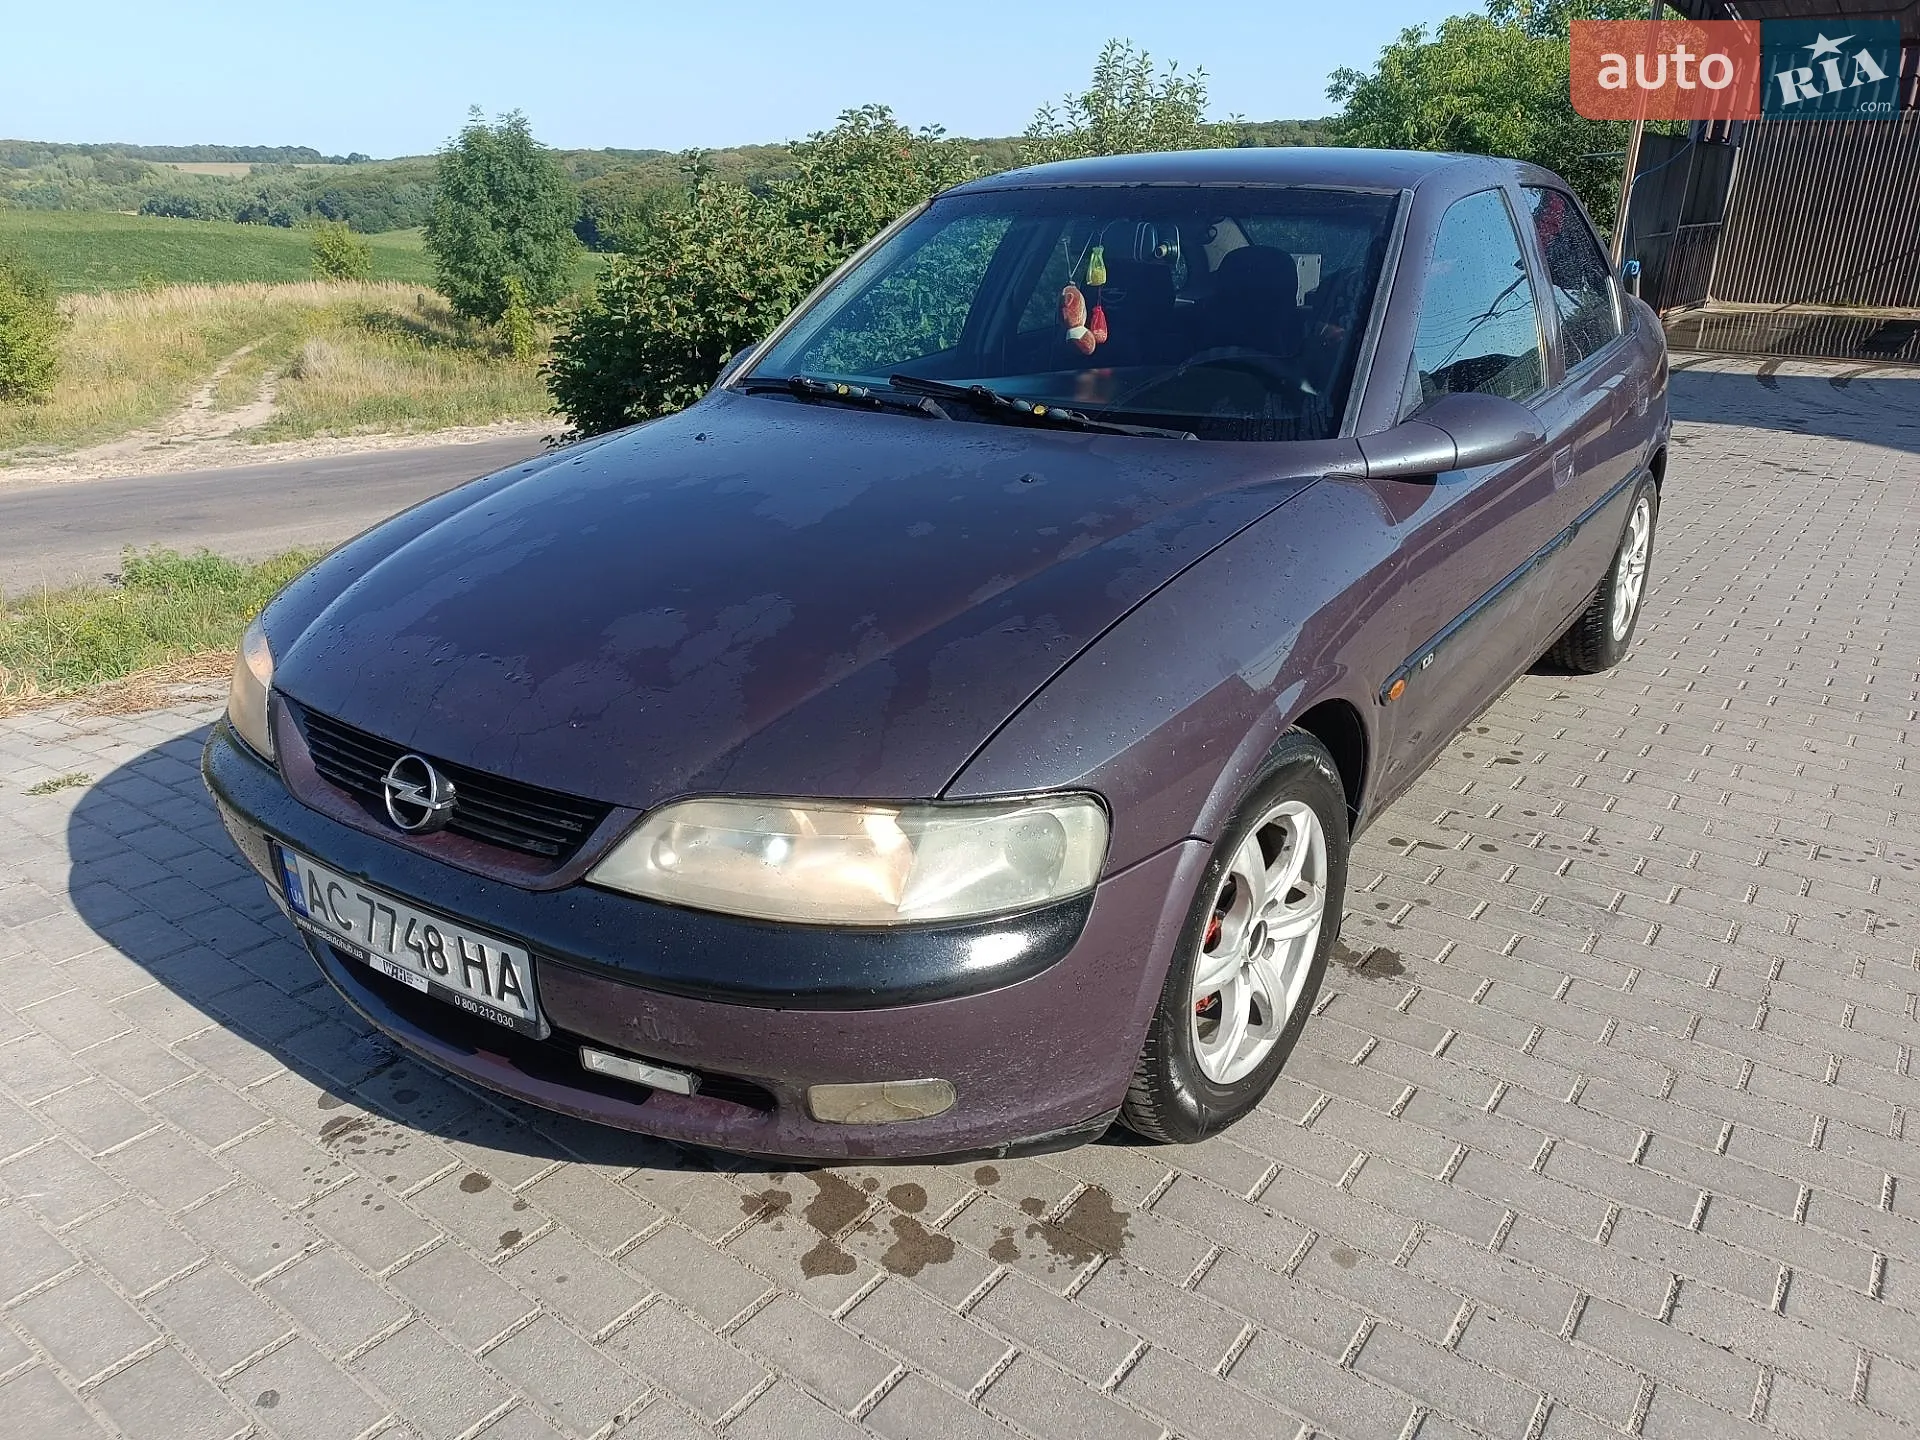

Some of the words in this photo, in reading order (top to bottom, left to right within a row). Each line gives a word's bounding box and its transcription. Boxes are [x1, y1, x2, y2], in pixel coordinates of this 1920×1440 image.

[1422, 652, 1434, 670] CD
[290, 887, 305, 907] UA
[307, 868, 353, 932] AC
[357, 893, 450, 976] 7748
[457, 936, 529, 1010] HA
[462, 998, 478, 1013] 800
[479, 1006, 496, 1021] 212
[497, 1013, 514, 1028] 030
